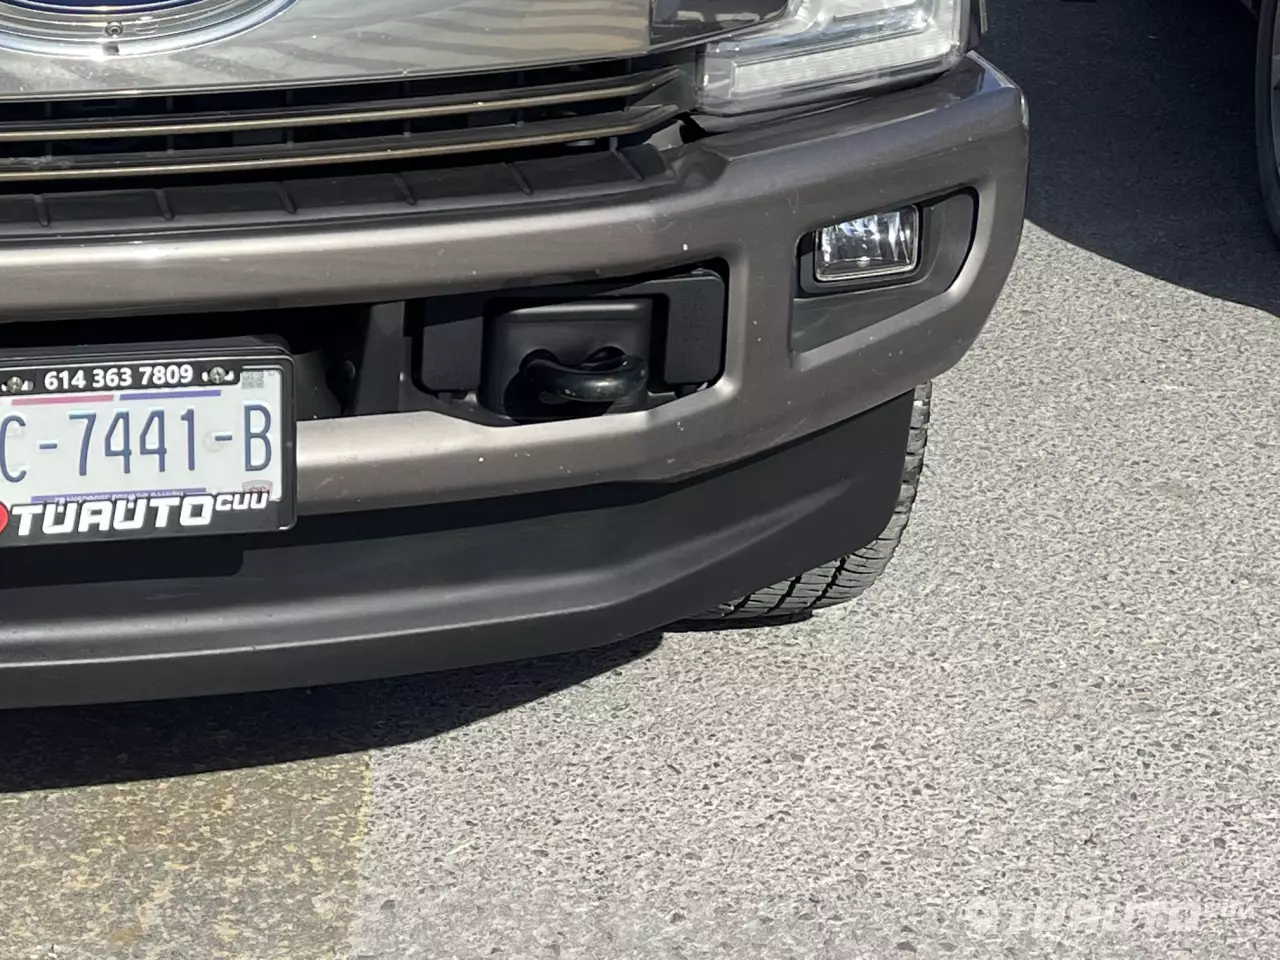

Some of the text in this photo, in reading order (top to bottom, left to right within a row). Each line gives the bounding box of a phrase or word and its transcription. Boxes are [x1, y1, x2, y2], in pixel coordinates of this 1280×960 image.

[44, 364, 194, 390] 614 363 7809
